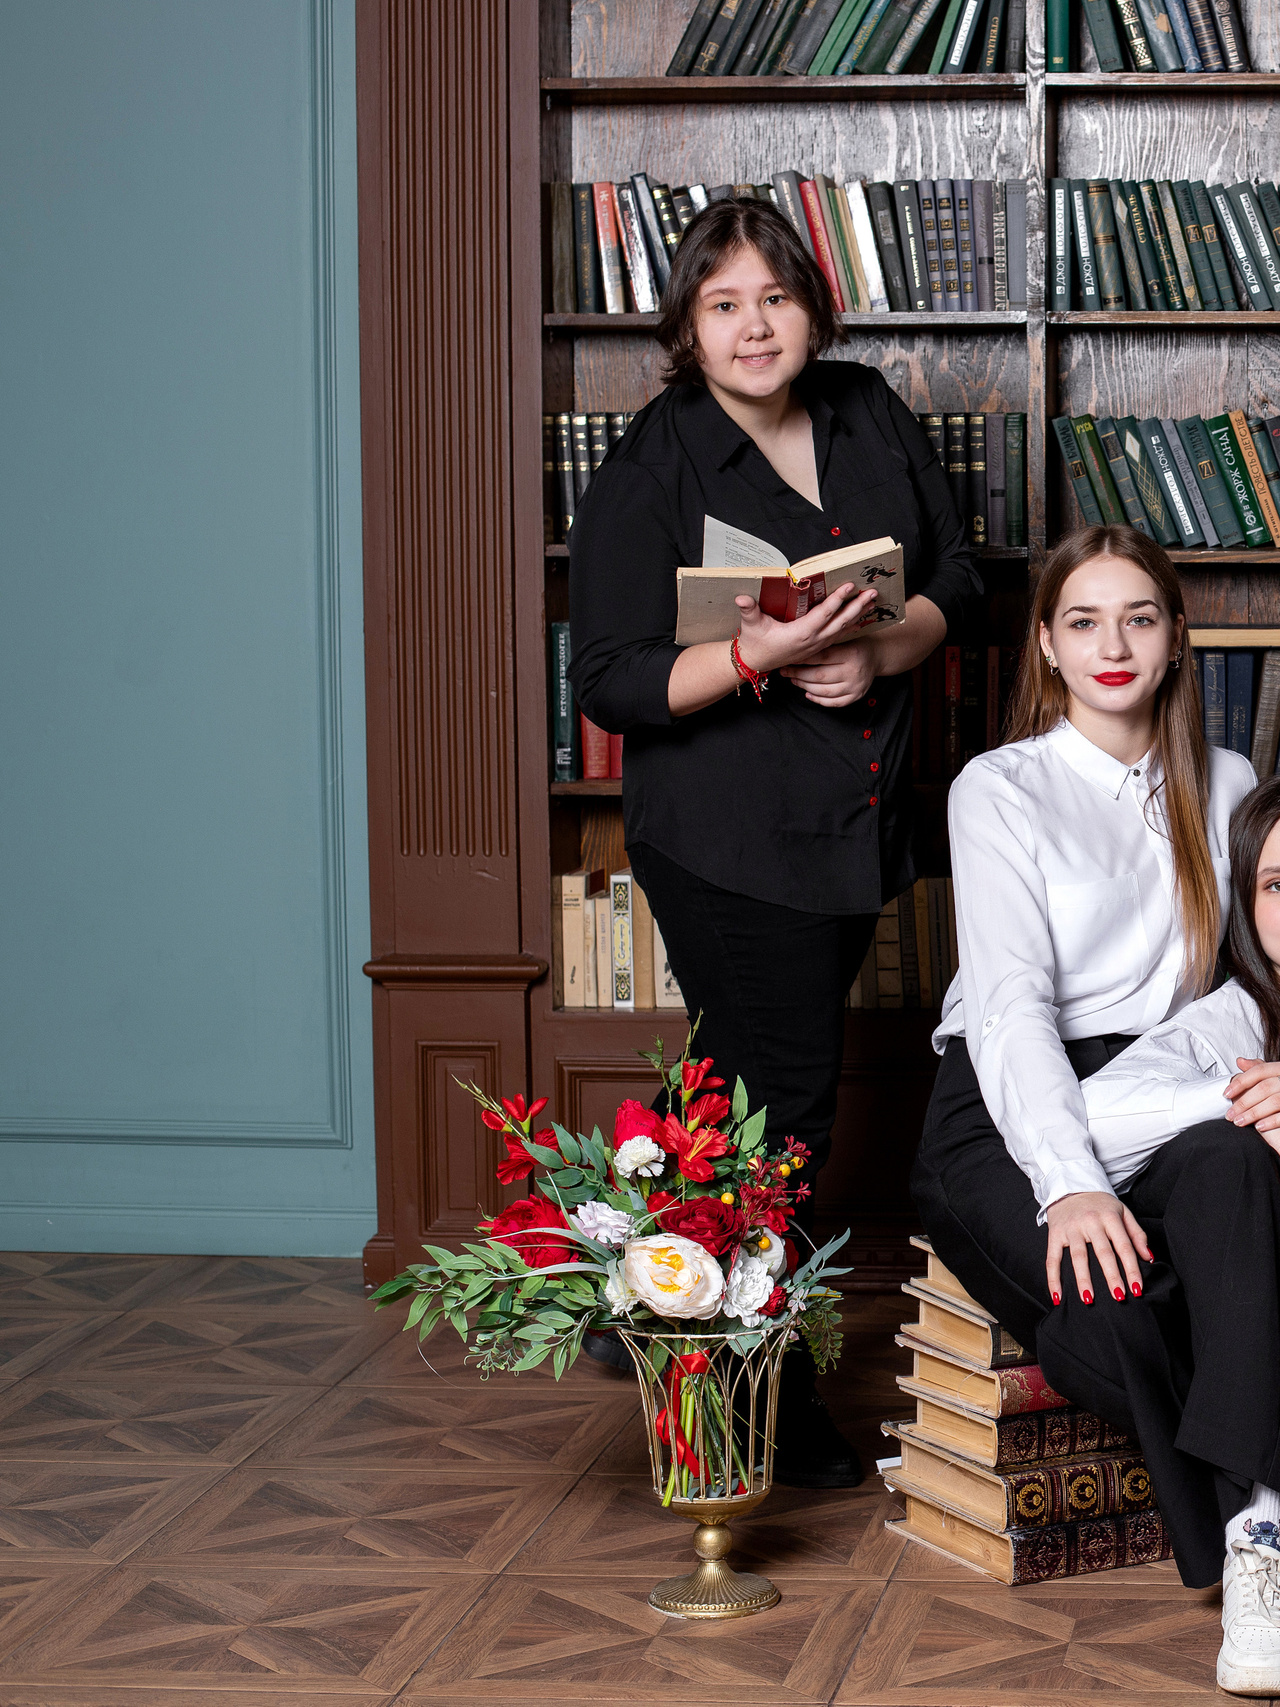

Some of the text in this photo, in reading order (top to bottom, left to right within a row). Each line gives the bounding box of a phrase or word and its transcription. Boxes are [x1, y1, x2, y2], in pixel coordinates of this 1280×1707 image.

[986, 17, 999, 66] СТЕНДАЛЬ
[1056, 190, 1064, 255] ГОЛСУОРСИ
[1074, 192, 1089, 257] ГОЛСУОРСИ
[1130, 194, 1146, 244] СТЕНДАЛЬ
[1188, 227, 1201, 241] 24
[1205, 226, 1217, 241] 19
[1216, 194, 1246, 258] ГОЛСУОРСИ
[1240, 193, 1280, 283] ДЖОН ГОЛСУОРСИ
[1056, 256, 1065, 285] ДЖОН
[1082, 257, 1094, 286] ДЖОН
[1240, 256, 1258, 285] ДЖОН
[1076, 422, 1094, 435] РУСЬ
[1235, 416, 1253, 451] ДЕТСТВЕ
[1201, 463, 1214, 476] 21
[1218, 432, 1250, 505] ЖОРЖ САНД
[1249, 459, 1267, 495] ПОВЕСТЬ
[1153, 445, 1193, 534] ДЖОН ГОЛСУОРСИ
[558, 632, 566, 678] БИОЛОГИИ
